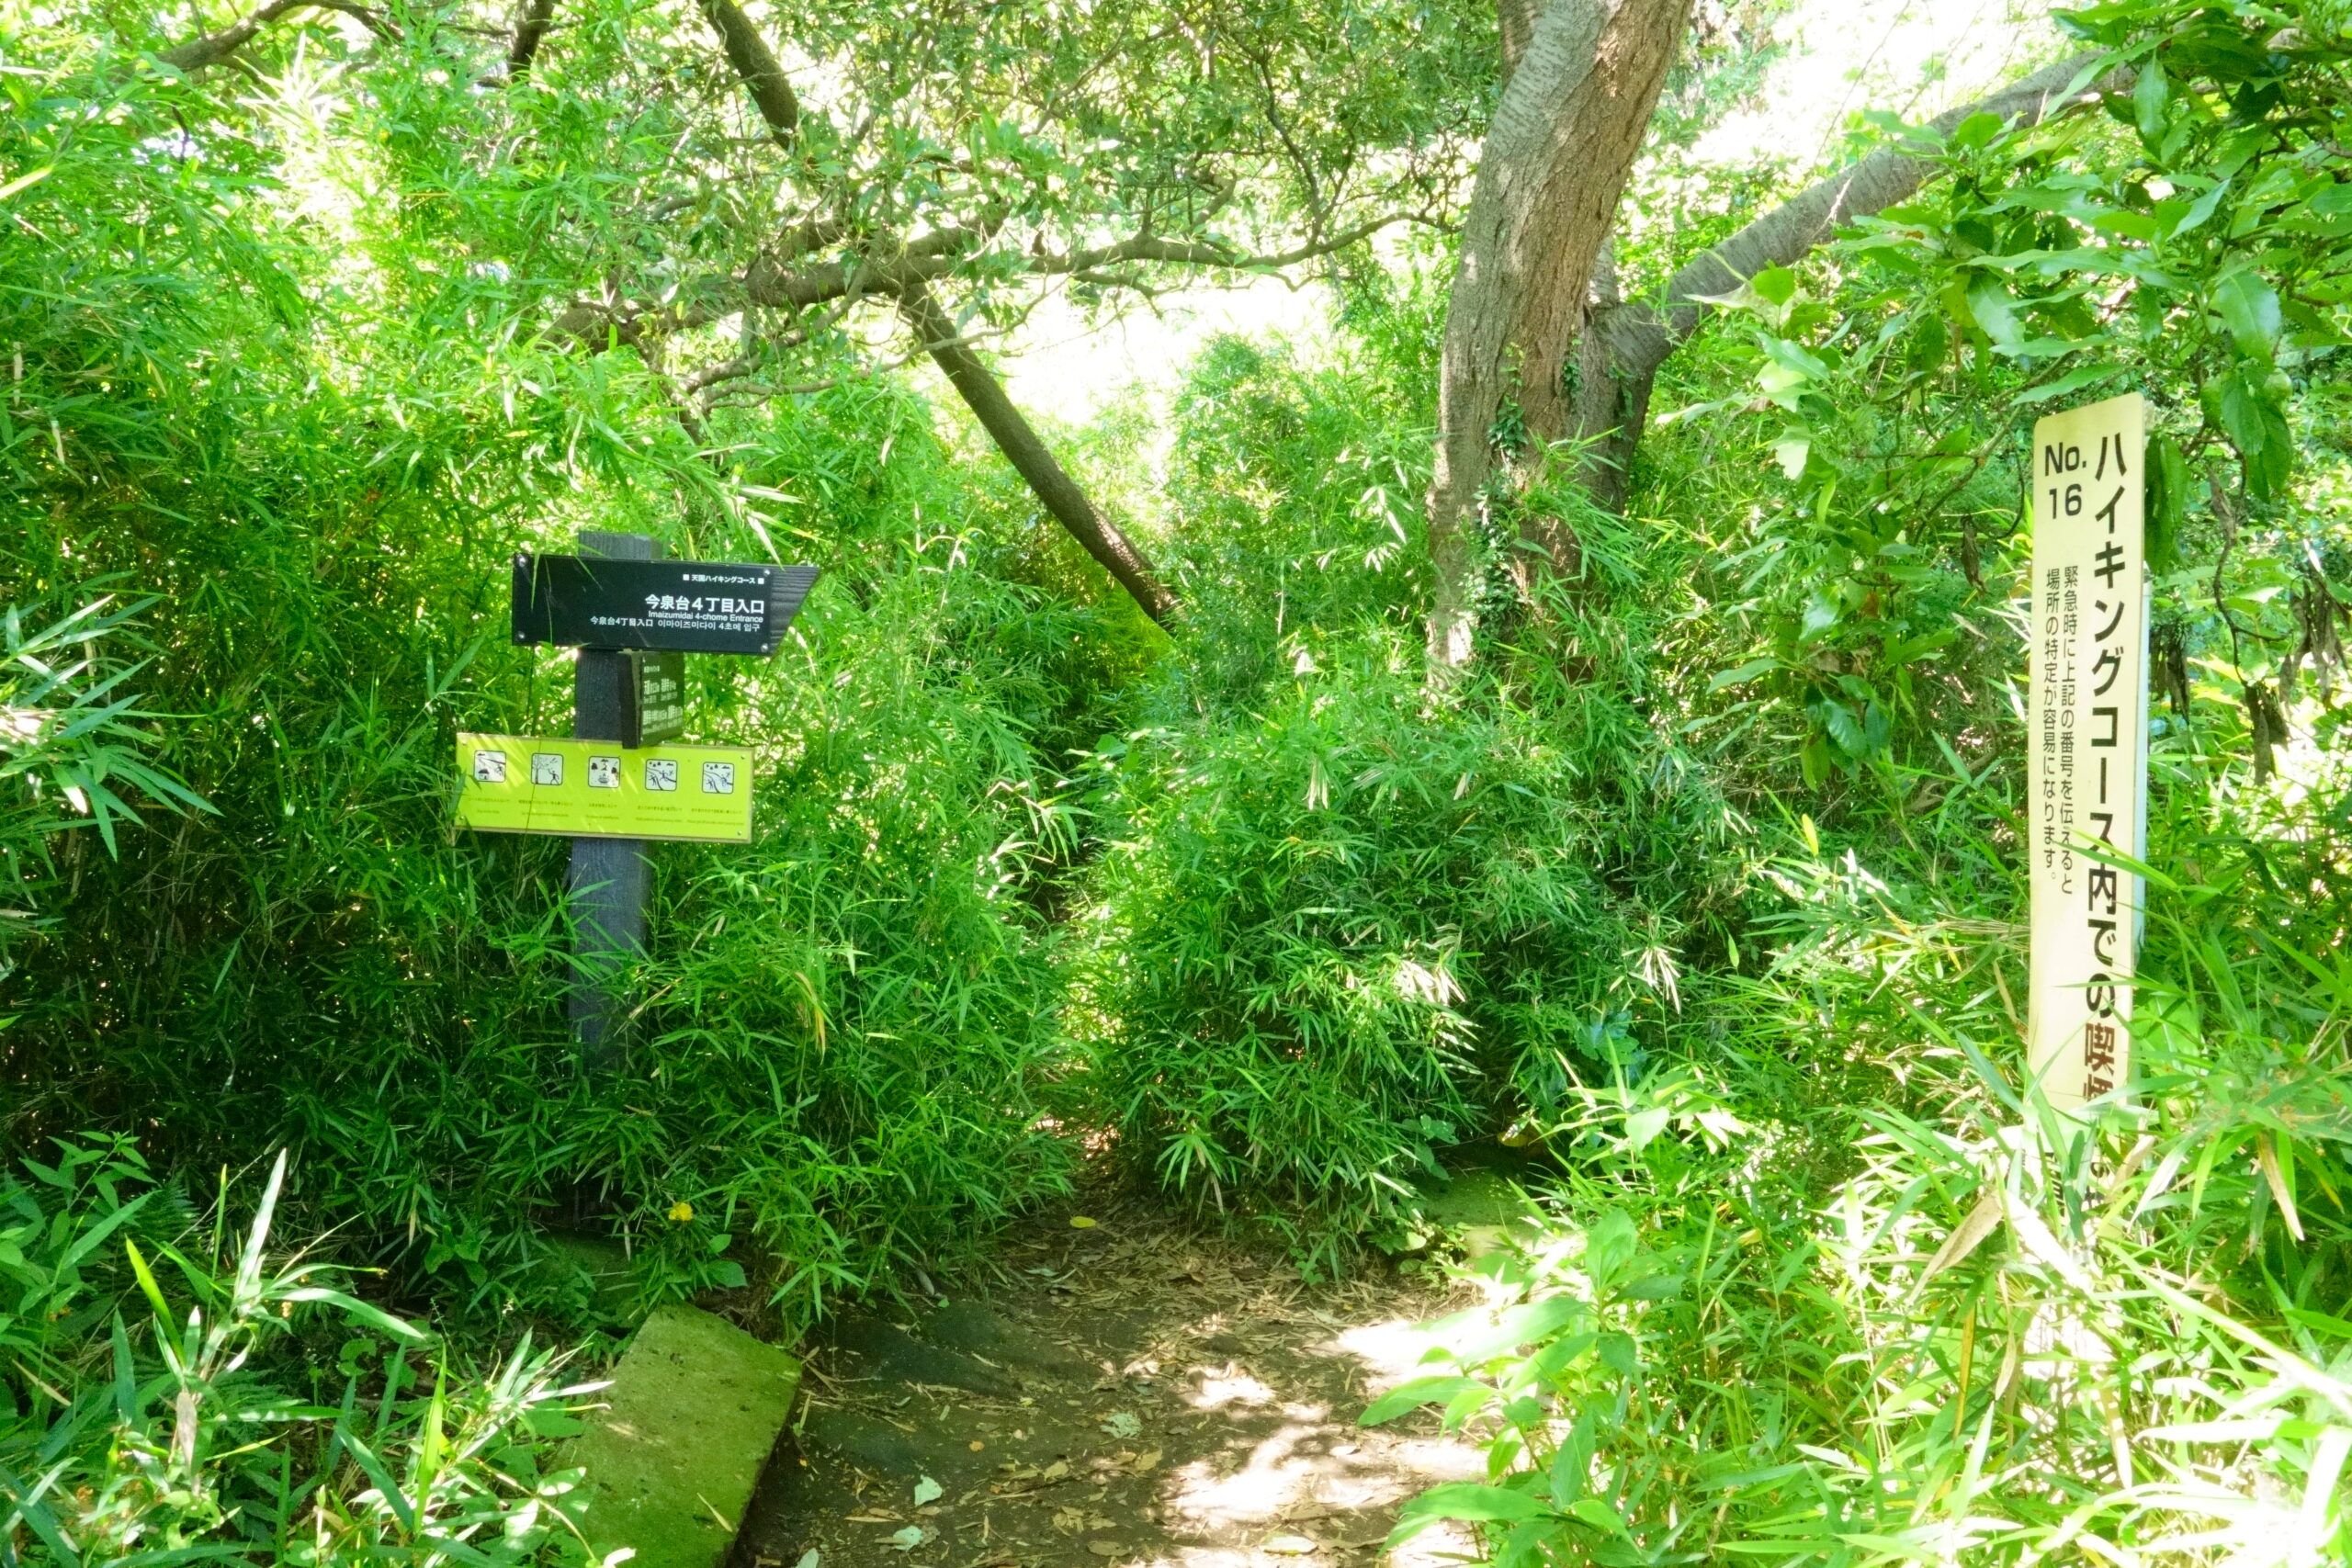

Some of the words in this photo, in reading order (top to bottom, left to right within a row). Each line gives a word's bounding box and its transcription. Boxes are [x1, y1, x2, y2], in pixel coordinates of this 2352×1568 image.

[2045, 442, 2086, 477] No.
[2049, 483, 2082, 520] 16
[645, 593, 764, 615] 今泉台4丁目入口
[648, 610, 694, 620] Imaizumidai
[695, 613, 729, 622] 4-chome
[729, 614, 763, 623] Entrance
[743, 623, 761, 633] 입구
